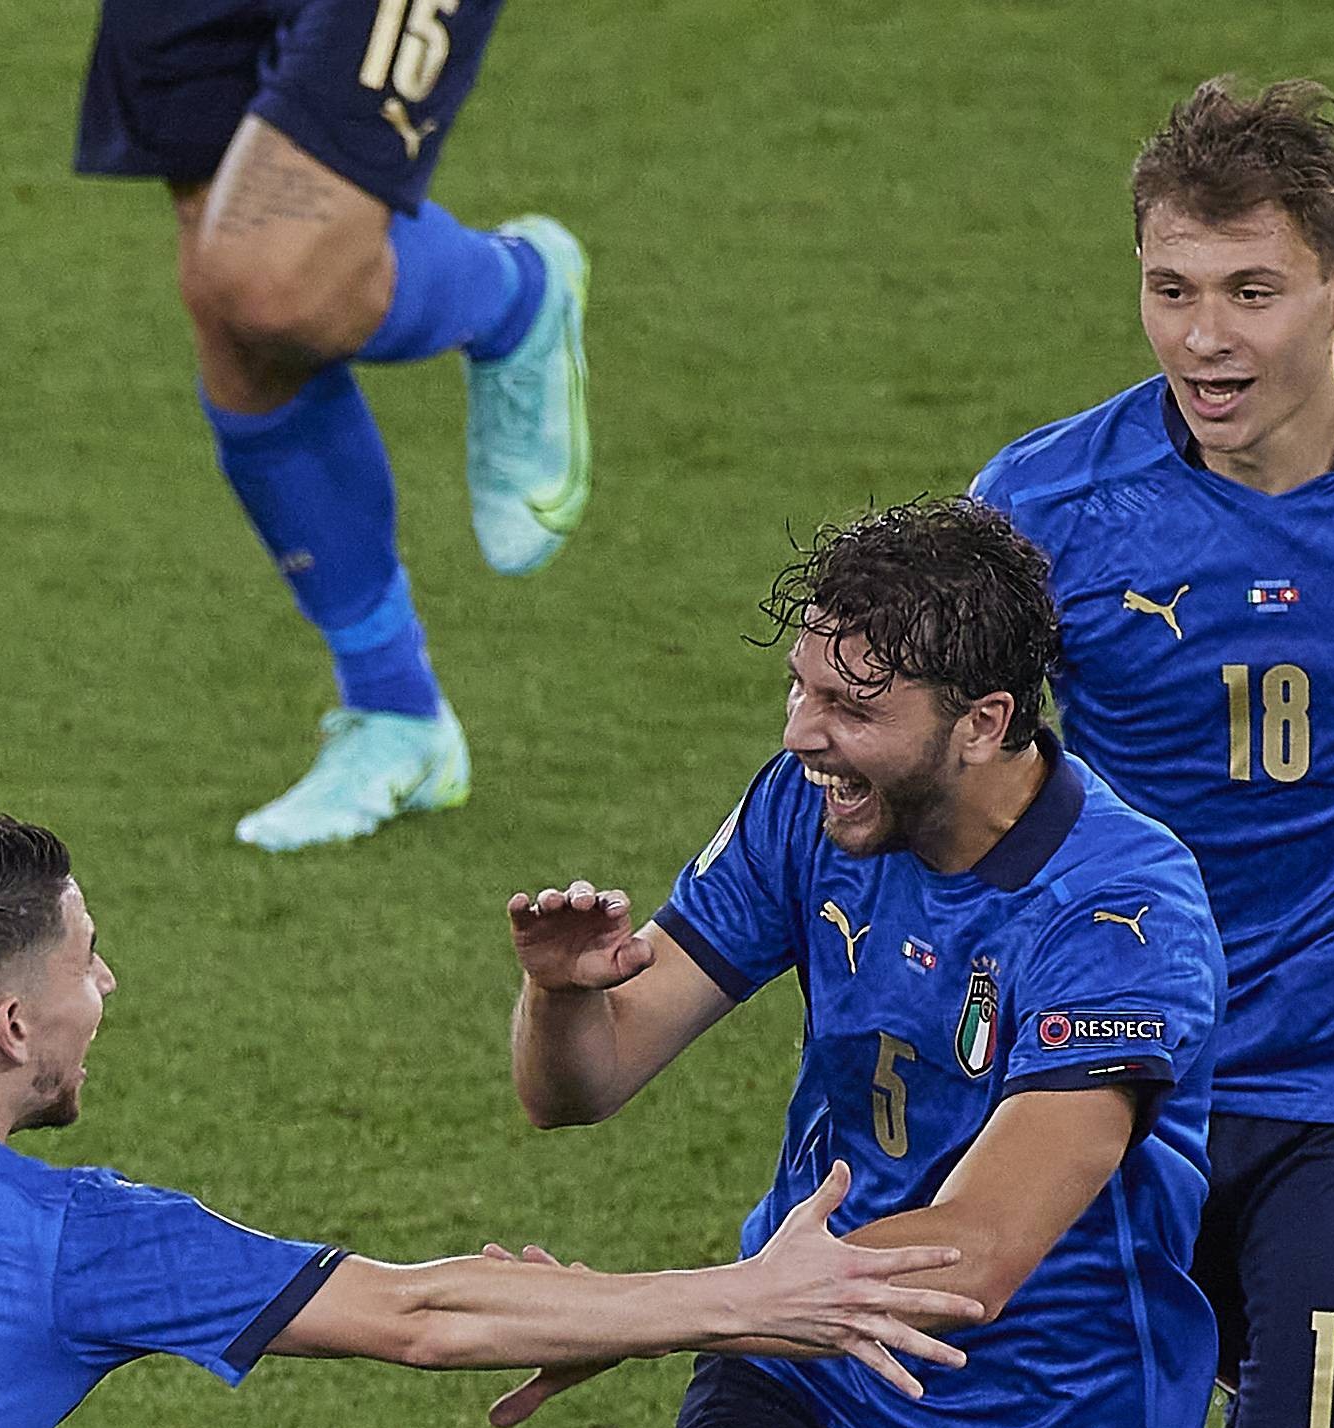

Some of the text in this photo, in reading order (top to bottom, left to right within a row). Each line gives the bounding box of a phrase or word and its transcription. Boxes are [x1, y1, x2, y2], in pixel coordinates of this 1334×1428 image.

[359, 0, 460, 103] 15
[1221, 663, 1310, 783] 18
[1074, 1020, 1165, 1038] RESPECT
[872, 1030, 915, 1158] 5
